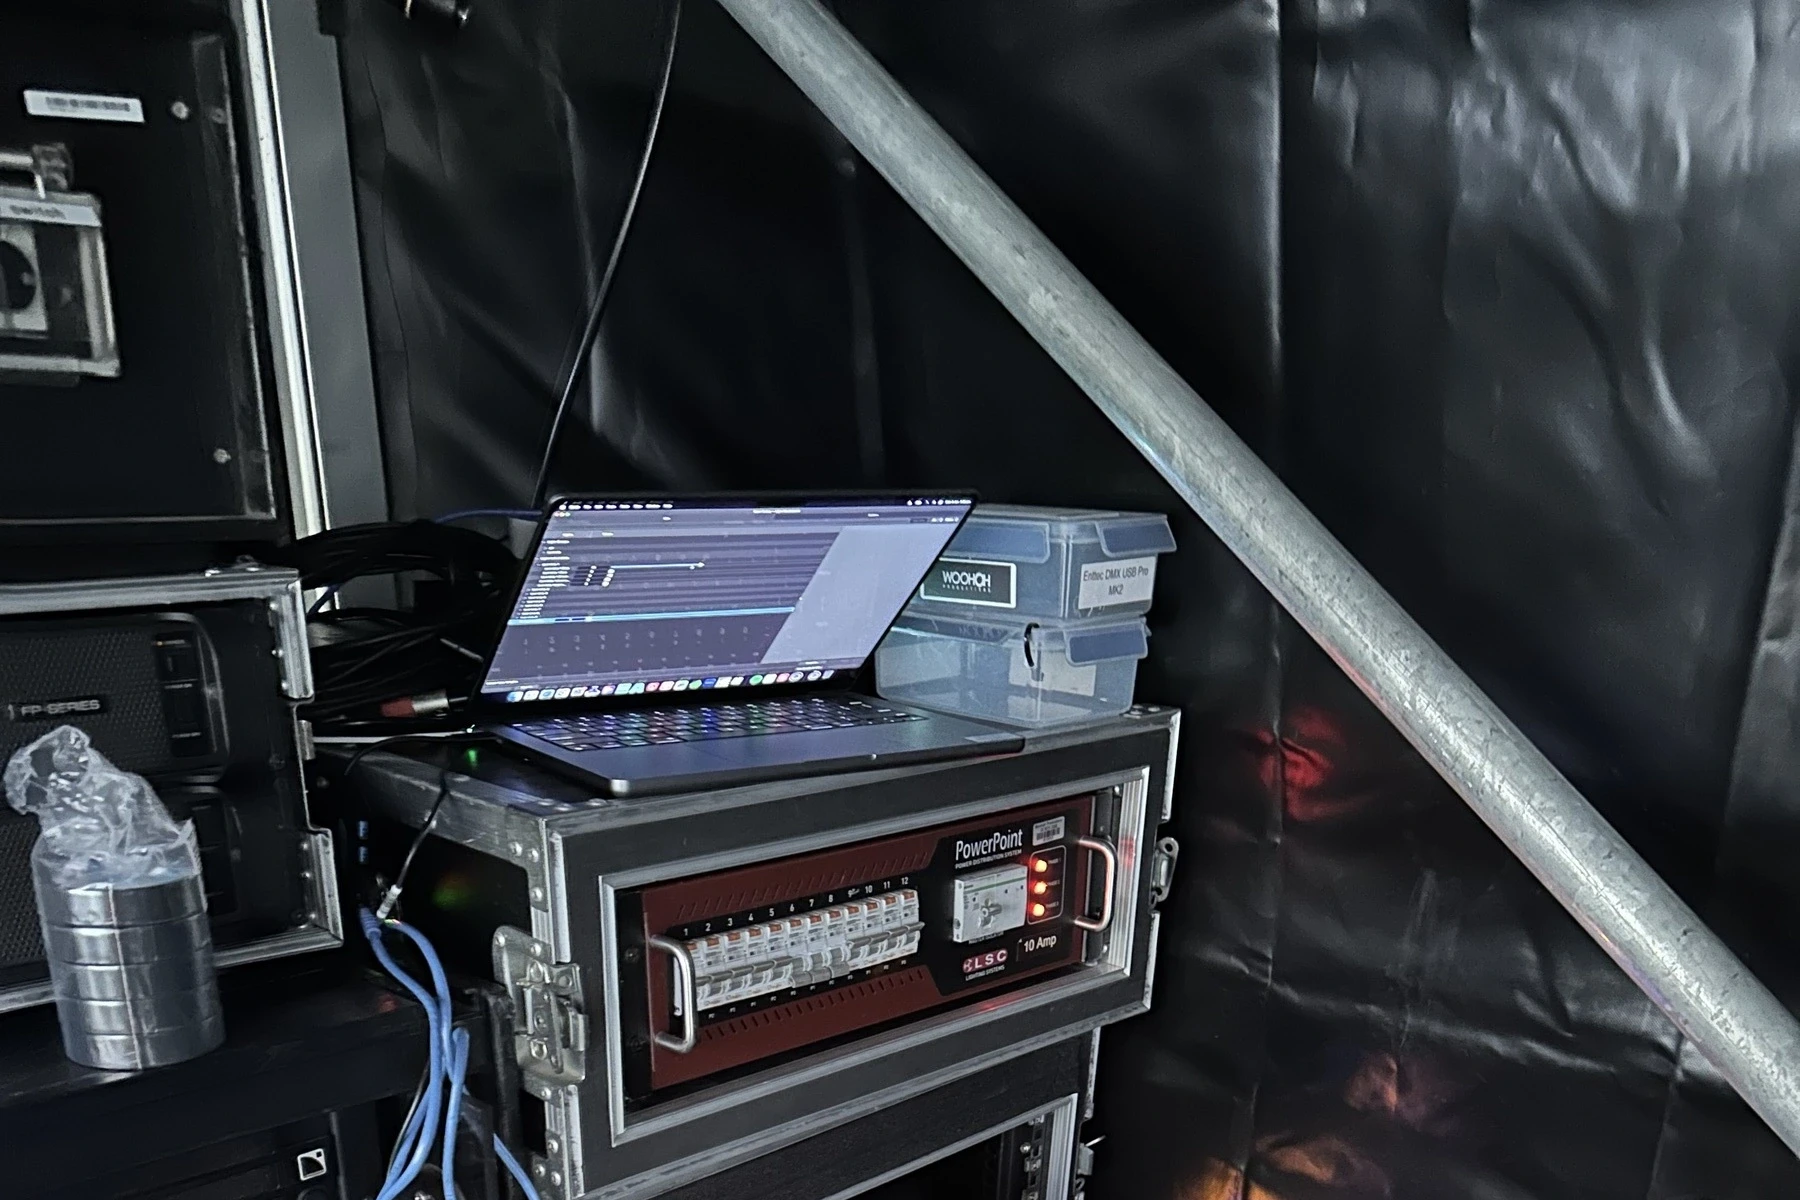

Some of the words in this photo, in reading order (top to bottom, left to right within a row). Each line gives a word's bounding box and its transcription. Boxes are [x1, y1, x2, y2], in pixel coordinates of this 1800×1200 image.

[1105, 567, 1121, 579] DMX
[1122, 566, 1137, 578] USB
[1138, 566, 1149, 577] Pro
[1108, 584, 1123, 595] MK2
[955, 829, 1023, 861] PowerPoint
[955, 859, 973, 869] POWER
[684, 928, 689, 937] 1
[705, 923, 711, 932] 2
[728, 918, 733, 927] 3
[748, 913, 754, 922] 4
[769, 908, 775, 917] 5
[789, 904, 795, 912] 6
[809, 899, 814, 907] 7
[828, 894, 834, 903] 8
[865, 885, 873, 894] 10
[883, 880, 891, 889] 11
[901, 877, 909, 886] 12
[1024, 938, 1035, 952] 10
[1036, 935, 1057, 950] Amp
